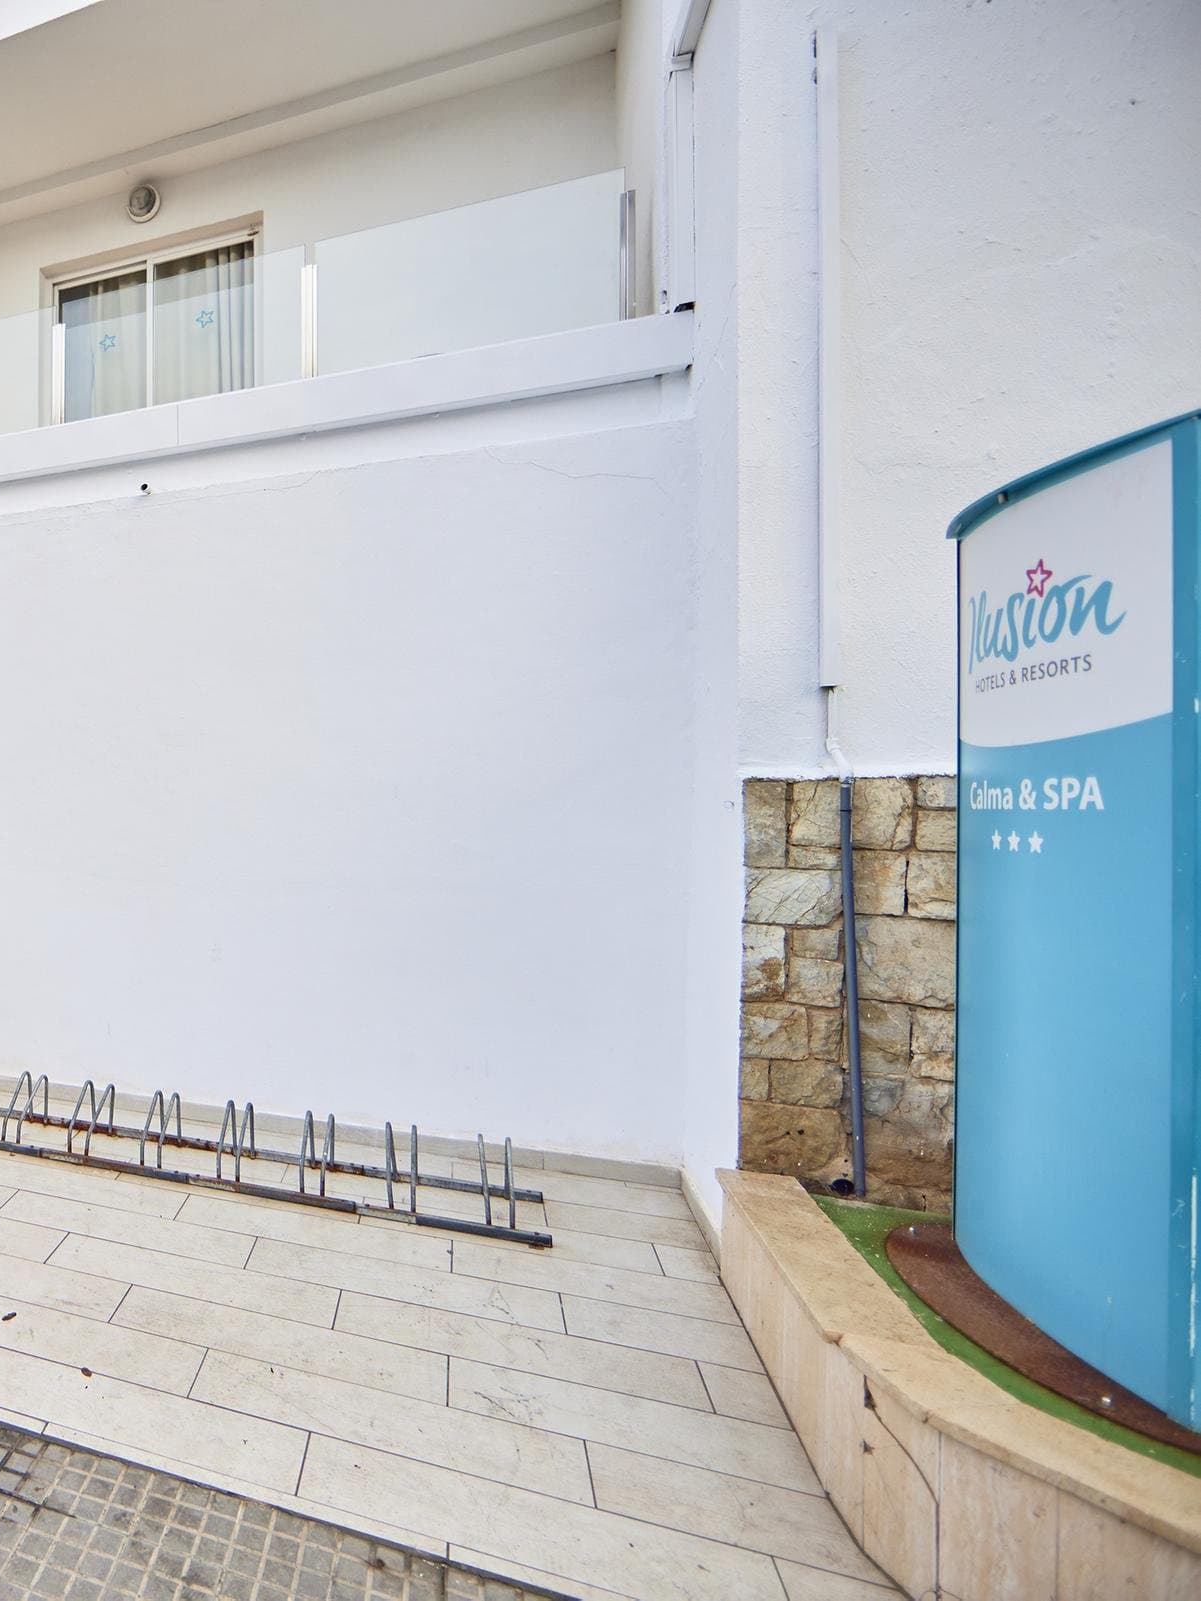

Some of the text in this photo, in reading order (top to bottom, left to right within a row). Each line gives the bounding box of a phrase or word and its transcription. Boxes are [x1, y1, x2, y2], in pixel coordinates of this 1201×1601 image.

[975, 654, 1092, 694] HOTELS & RESORTS
[969, 776, 1105, 811] Calma & SPA
